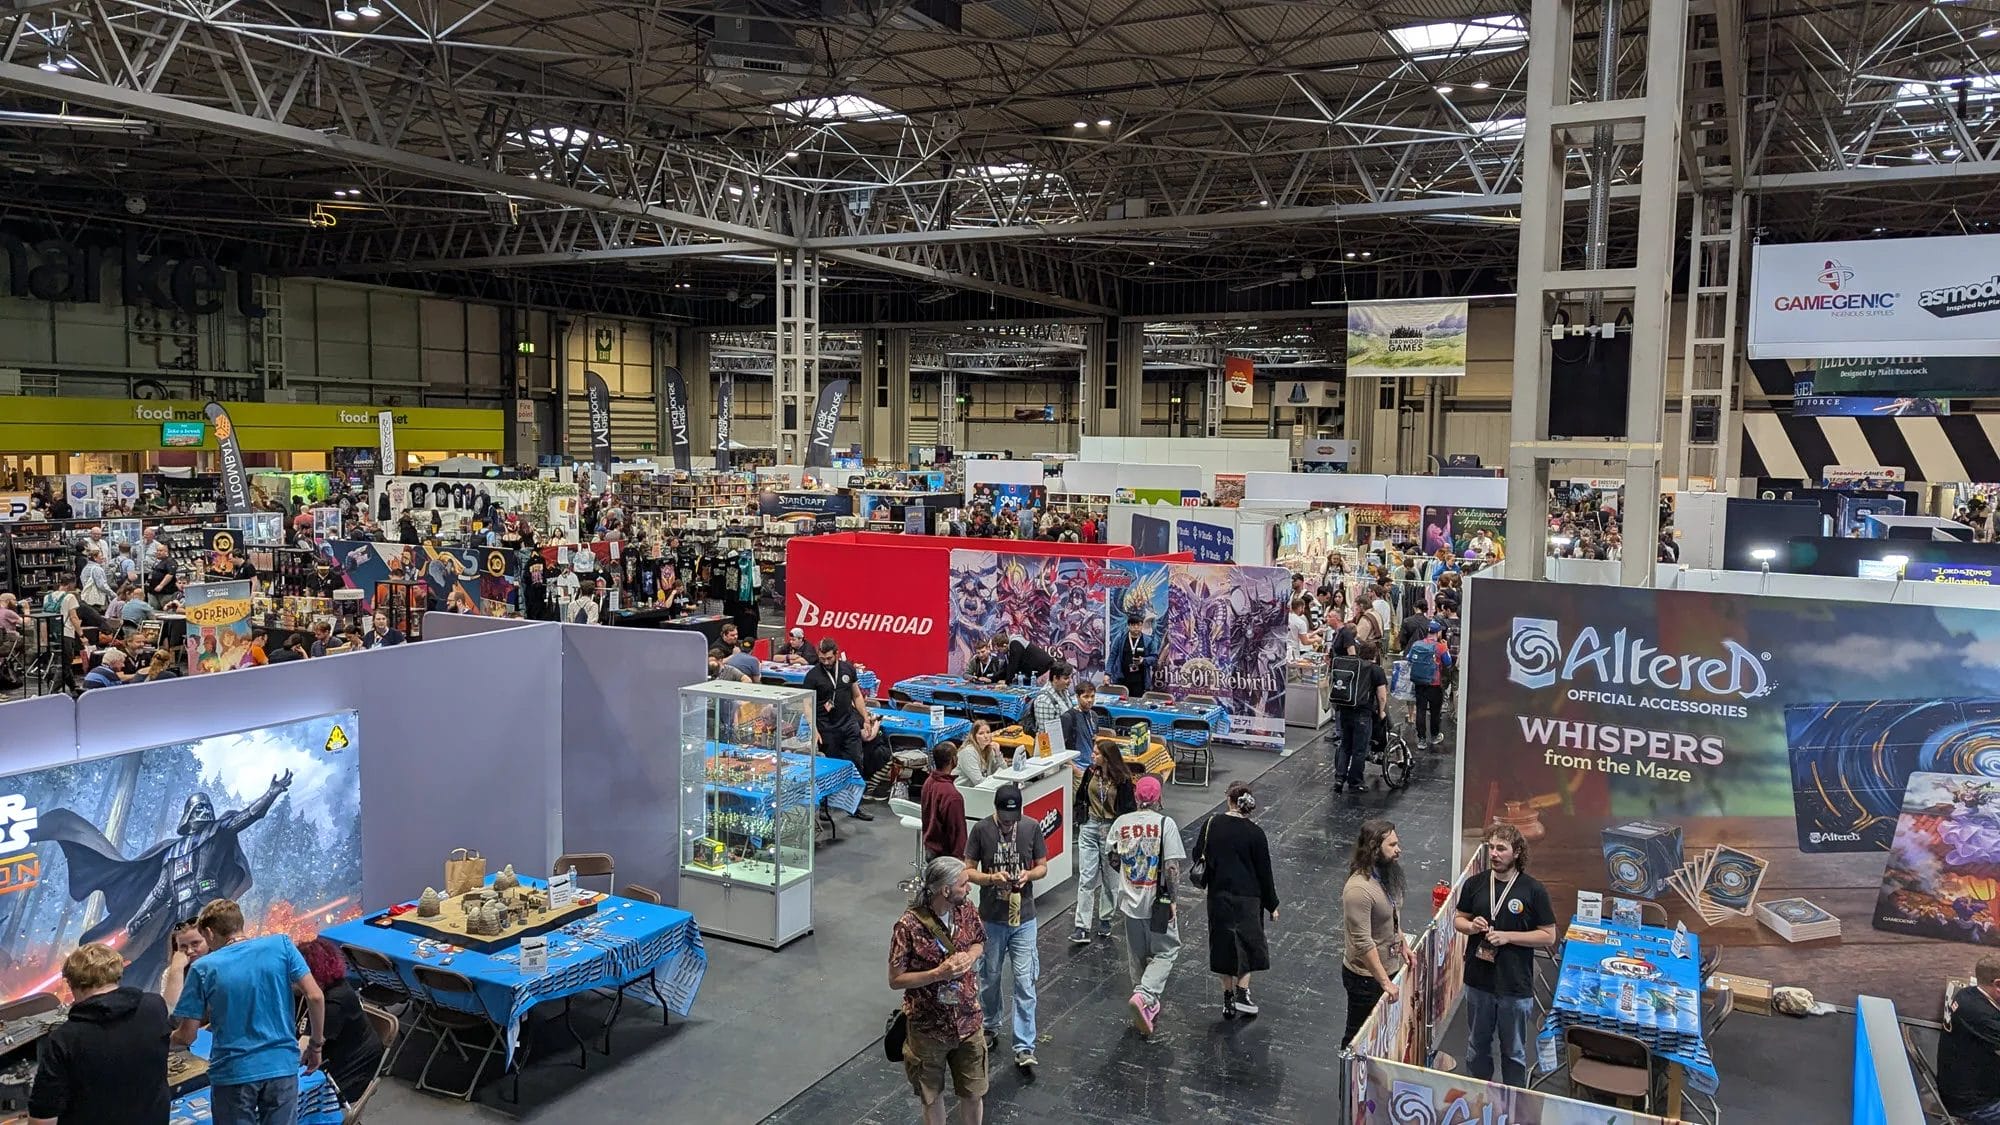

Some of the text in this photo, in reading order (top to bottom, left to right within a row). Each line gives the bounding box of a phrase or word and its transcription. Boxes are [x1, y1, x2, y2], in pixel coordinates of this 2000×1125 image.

[1946, 302, 1976, 311] Inspired
[136, 405, 172, 419] food
[340, 411, 368, 423] food
[1183, 498, 1198, 507] NO
[1458, 518, 1502, 527] Apprentice
[194, 606, 242, 623] OFRENDA
[821, 611, 933, 635] BUSHIROAD
[1151, 666, 1277, 693] ghts Of Rebirth
[1567, 689, 1748, 718] OFFICIAL ACCESSORIES
[1517, 715, 1725, 765] WHISPERS
[1544, 750, 1692, 783] from the Maze
[1040, 808, 1058, 831] odee
